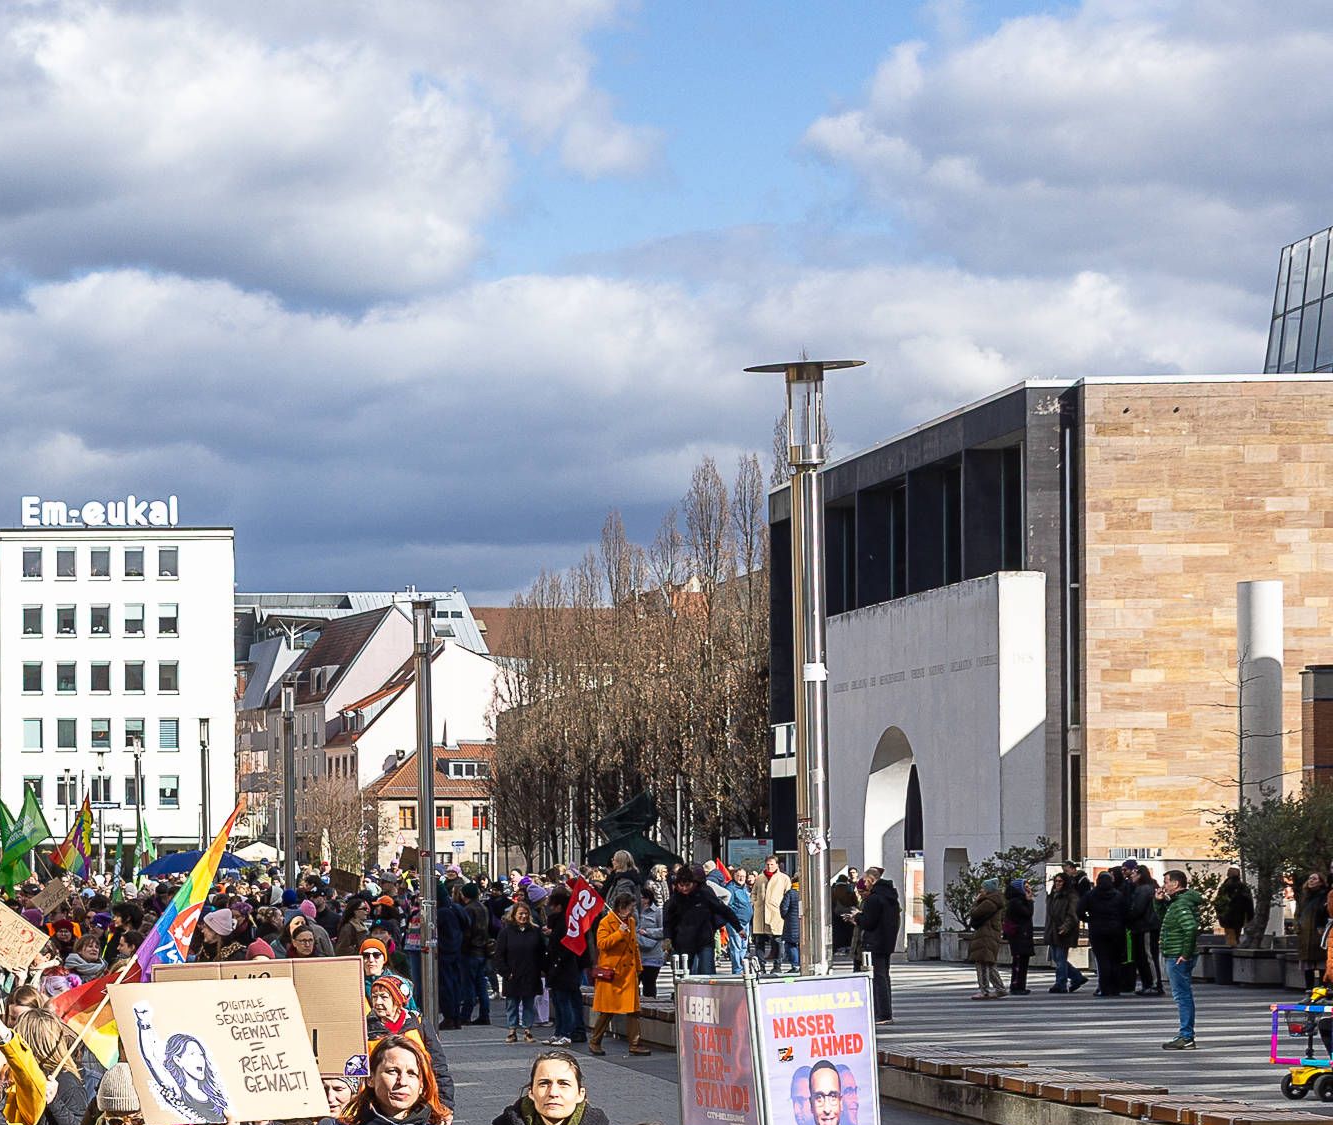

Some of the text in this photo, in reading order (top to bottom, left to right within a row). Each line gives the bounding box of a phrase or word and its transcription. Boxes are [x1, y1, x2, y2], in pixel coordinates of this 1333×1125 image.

[21, 495, 179, 527] Em-eukal
[567, 889, 597, 939] SPD
[217, 997, 265, 1012] DIGITALE
[683, 995, 720, 1024] LEBEN
[231, 1024, 280, 1041] GEWALT
[693, 1024, 733, 1054] STATT
[773, 1014, 835, 1039] NASSER
[810, 1033, 863, 1058] AHMED
[239, 1052, 289, 1074] REALE
[694, 1055, 732, 1081] LEER-
[244, 1072, 309, 1093] GEWALT!
[696, 1081, 751, 1114] STAND!
